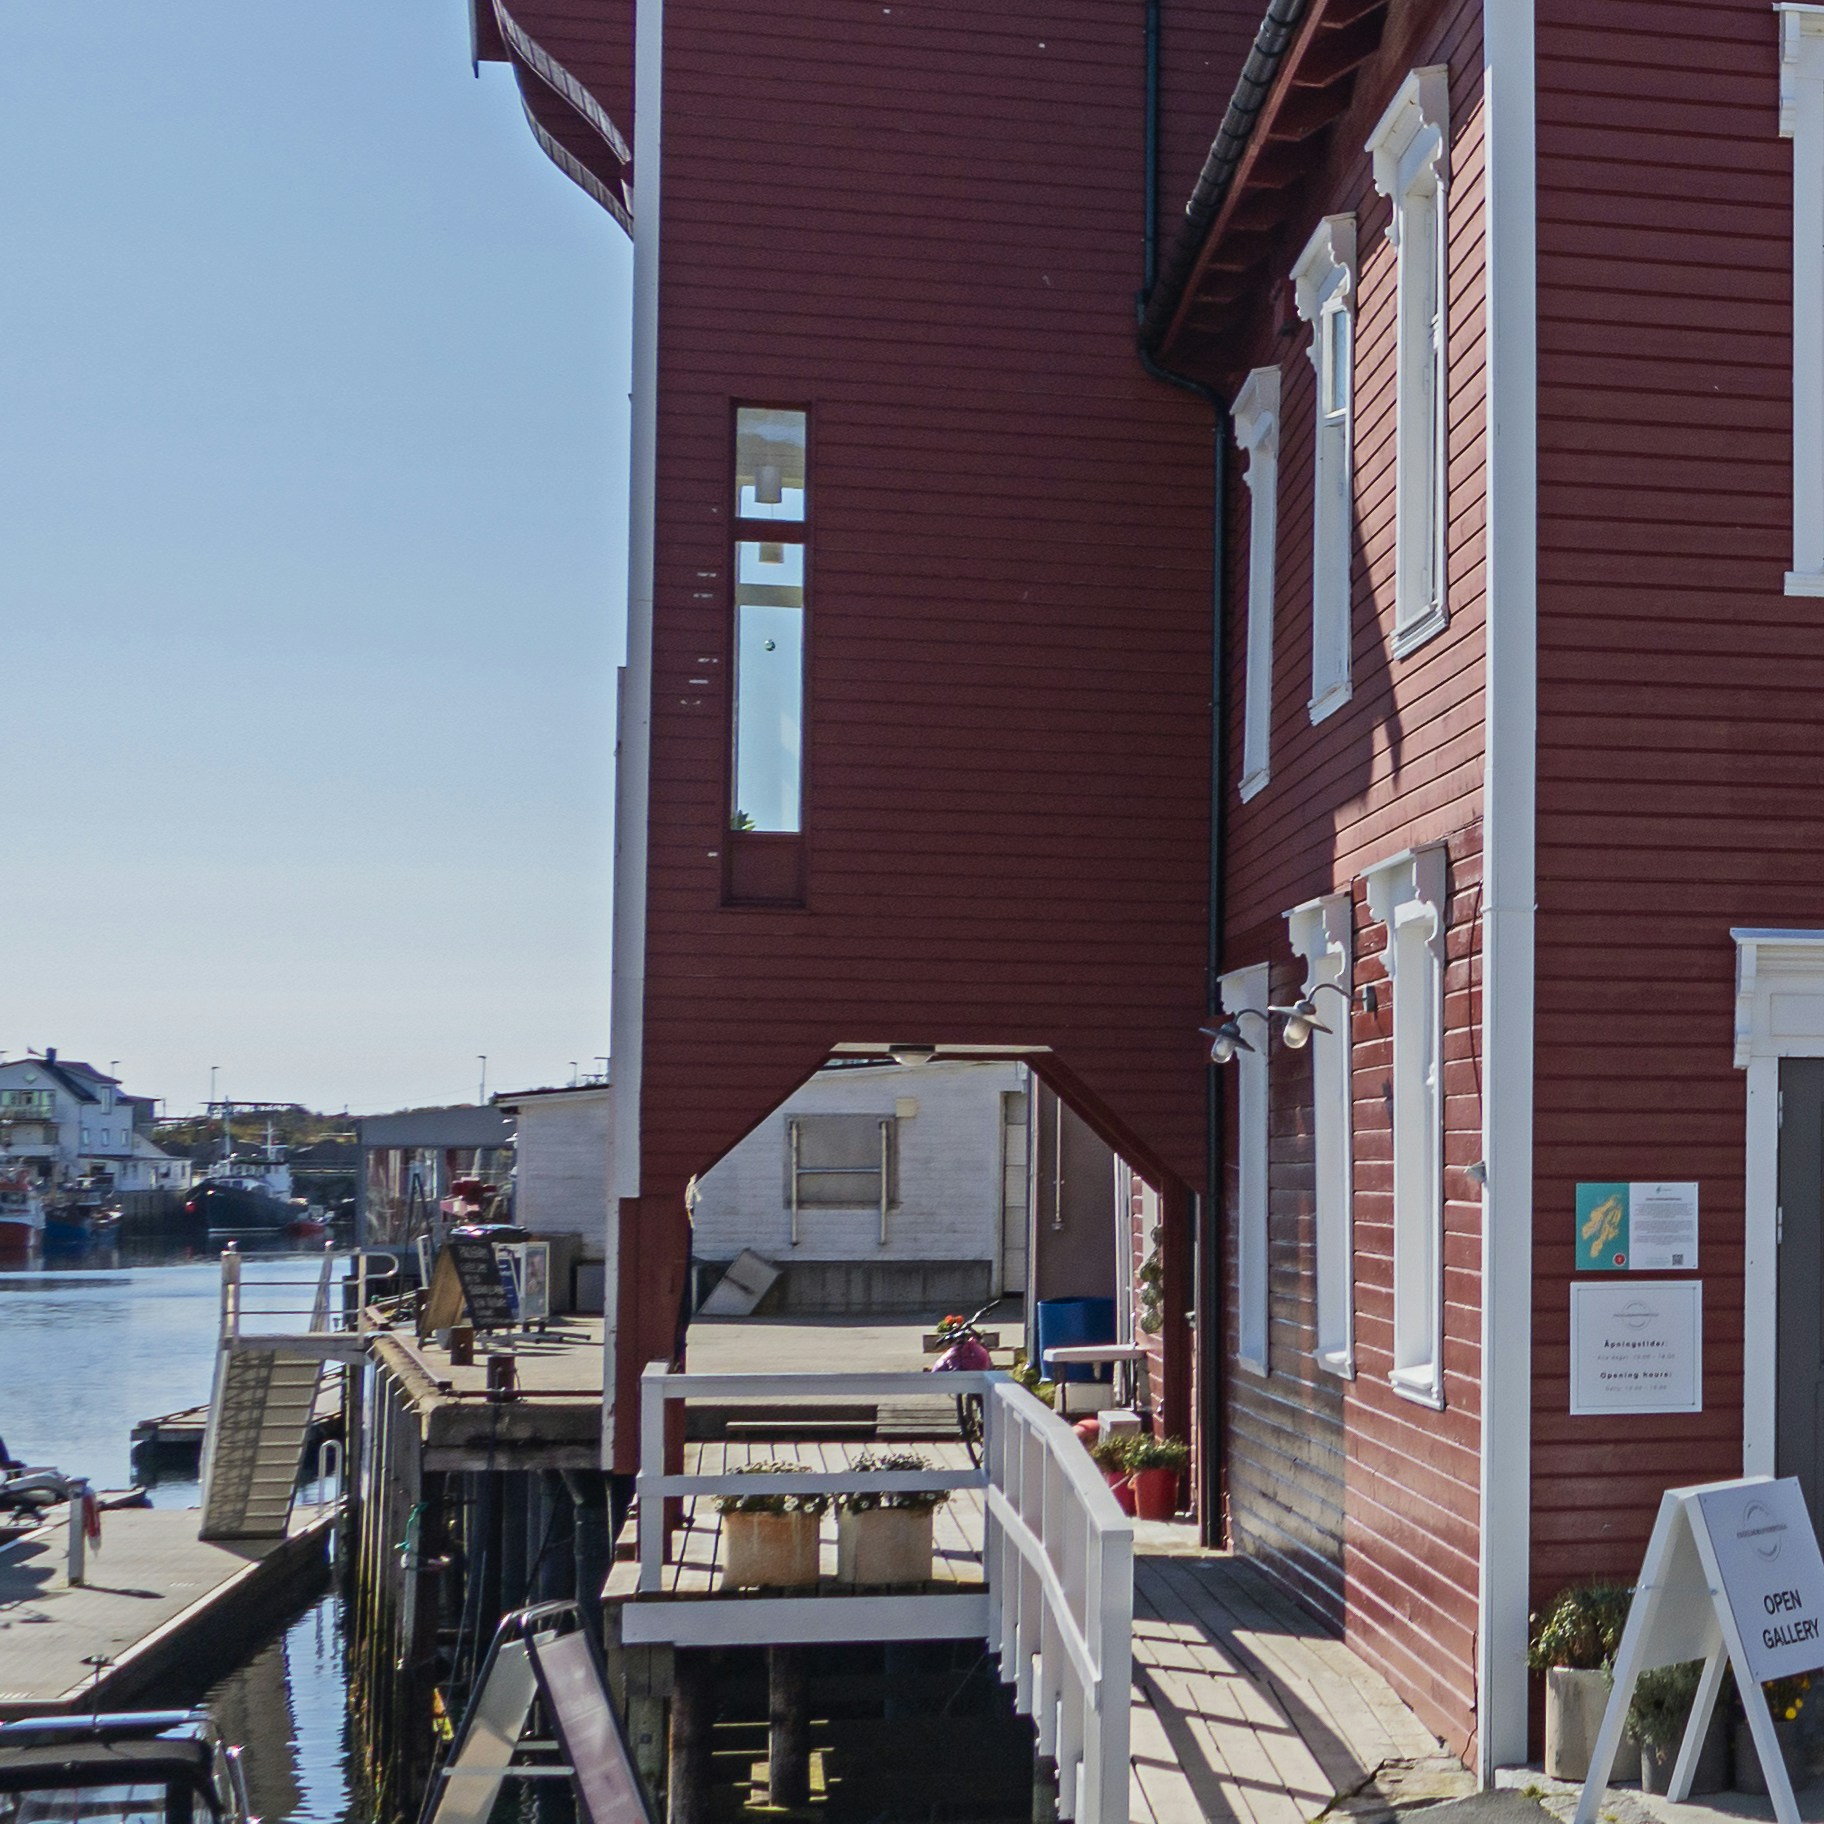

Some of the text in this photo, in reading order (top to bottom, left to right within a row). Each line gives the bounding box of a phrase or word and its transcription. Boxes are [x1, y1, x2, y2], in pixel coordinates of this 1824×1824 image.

[1599, 1371, 1639, 1380] Opening
[1763, 1589, 1803, 1616] OPEN
[1762, 1617, 1820, 1650] GALLERY
